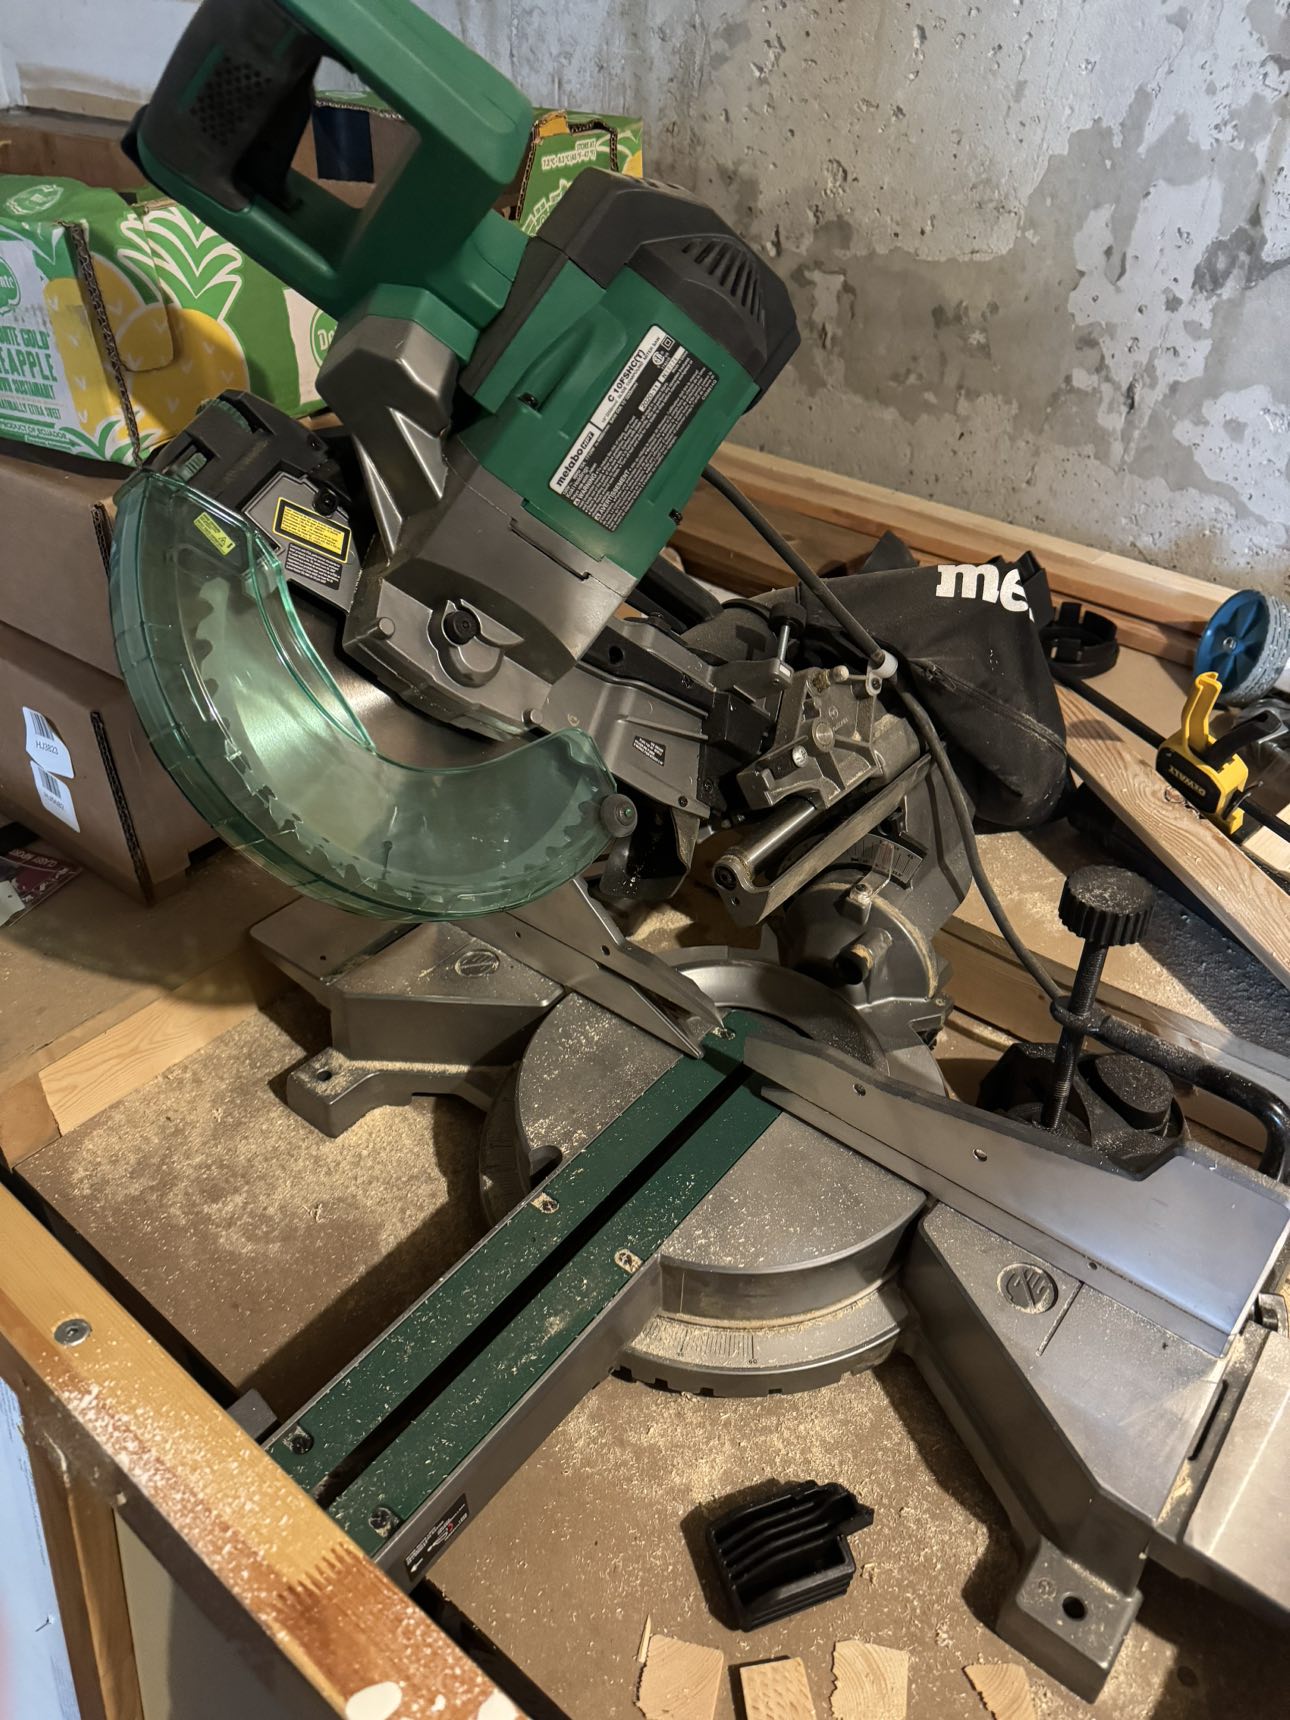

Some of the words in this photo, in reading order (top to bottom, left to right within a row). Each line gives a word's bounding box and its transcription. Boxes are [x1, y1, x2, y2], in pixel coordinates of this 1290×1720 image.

[607, 394, 615, 403] C
[612, 349, 645, 394] 10FSHC(T)
[556, 447, 584, 487] metabo
[578, 473, 598, 499] WARNING
[598, 468, 631, 514] AVERTISSEMENT
[936, 564, 1034, 622] me
[1169, 765, 1206, 797] DEWALT
